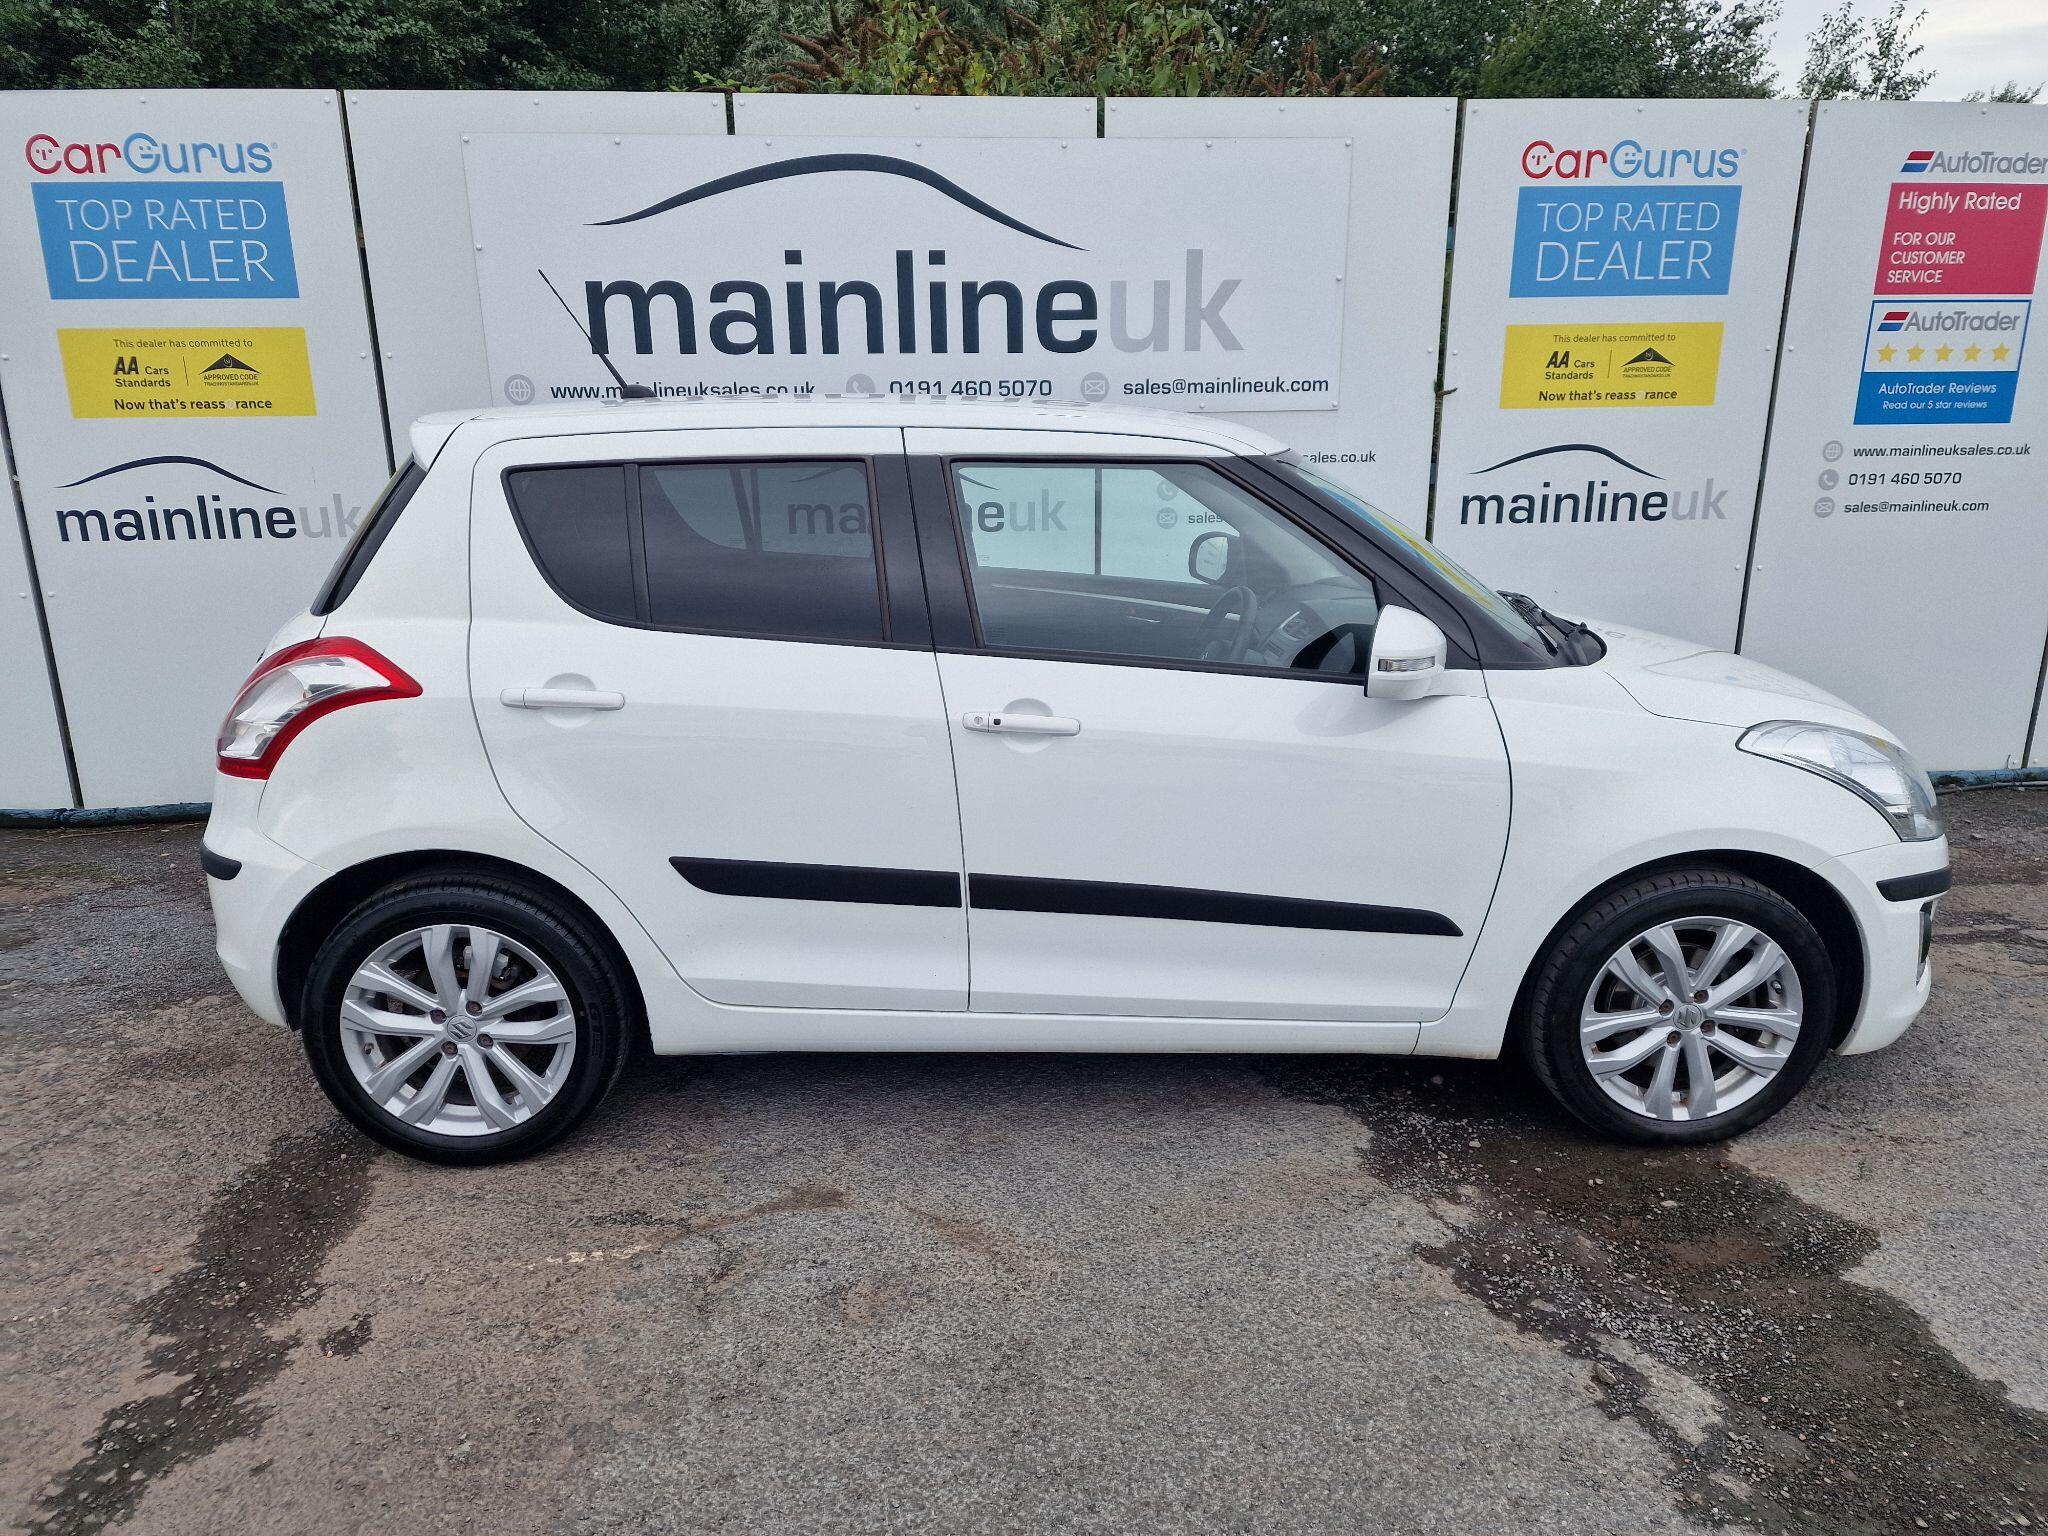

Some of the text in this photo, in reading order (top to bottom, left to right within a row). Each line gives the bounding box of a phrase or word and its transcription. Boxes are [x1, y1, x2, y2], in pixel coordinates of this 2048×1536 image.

[1928, 151, 2048, 174] AutoTrader
[1899, 192, 2022, 214] Highly Rated
[55, 199, 268, 231] TOP RATED
[1536, 202, 1720, 233] TOP RATED
[1893, 232, 1956, 246] FOR OUR
[70, 239, 276, 283] DEALER
[1536, 240, 1713, 282] DEALER
[1890, 251, 1966, 264] CUSTOMER
[1887, 270, 1943, 283] SERVICE
[583, 249, 1245, 356] mainlineuk
[1904, 311, 2021, 332] AutoTrader
[113, 338, 253, 348] This dealer has committed to
[1554, 333, 1676, 343] This dealer has committed to
[114, 356, 169, 375] AA Cars
[1546, 350, 1595, 368] AA Cars
[1545, 371, 1594, 380] Standards
[115, 378, 171, 388] Standards
[951, 380, 992, 396] 460
[999, 380, 1052, 397] 5070
[1123, 377, 1328, 395] sales@mainlineuk.com
[1878, 382, 1997, 395] AutoTrader Reviews
[1539, 390, 1678, 402] Now that's reassrance
[114, 397, 272, 410] Now that's reassrance
[1882, 401, 1987, 410] Read our 5 star reviews
[1853, 444, 2031, 457] www.mainlineuksales.co.uk
[1848, 472, 1962, 486] 0191 460 5070
[1460, 478, 1729, 525] mainlineuk
[1844, 500, 1989, 513] sales@mainlineuk.com
